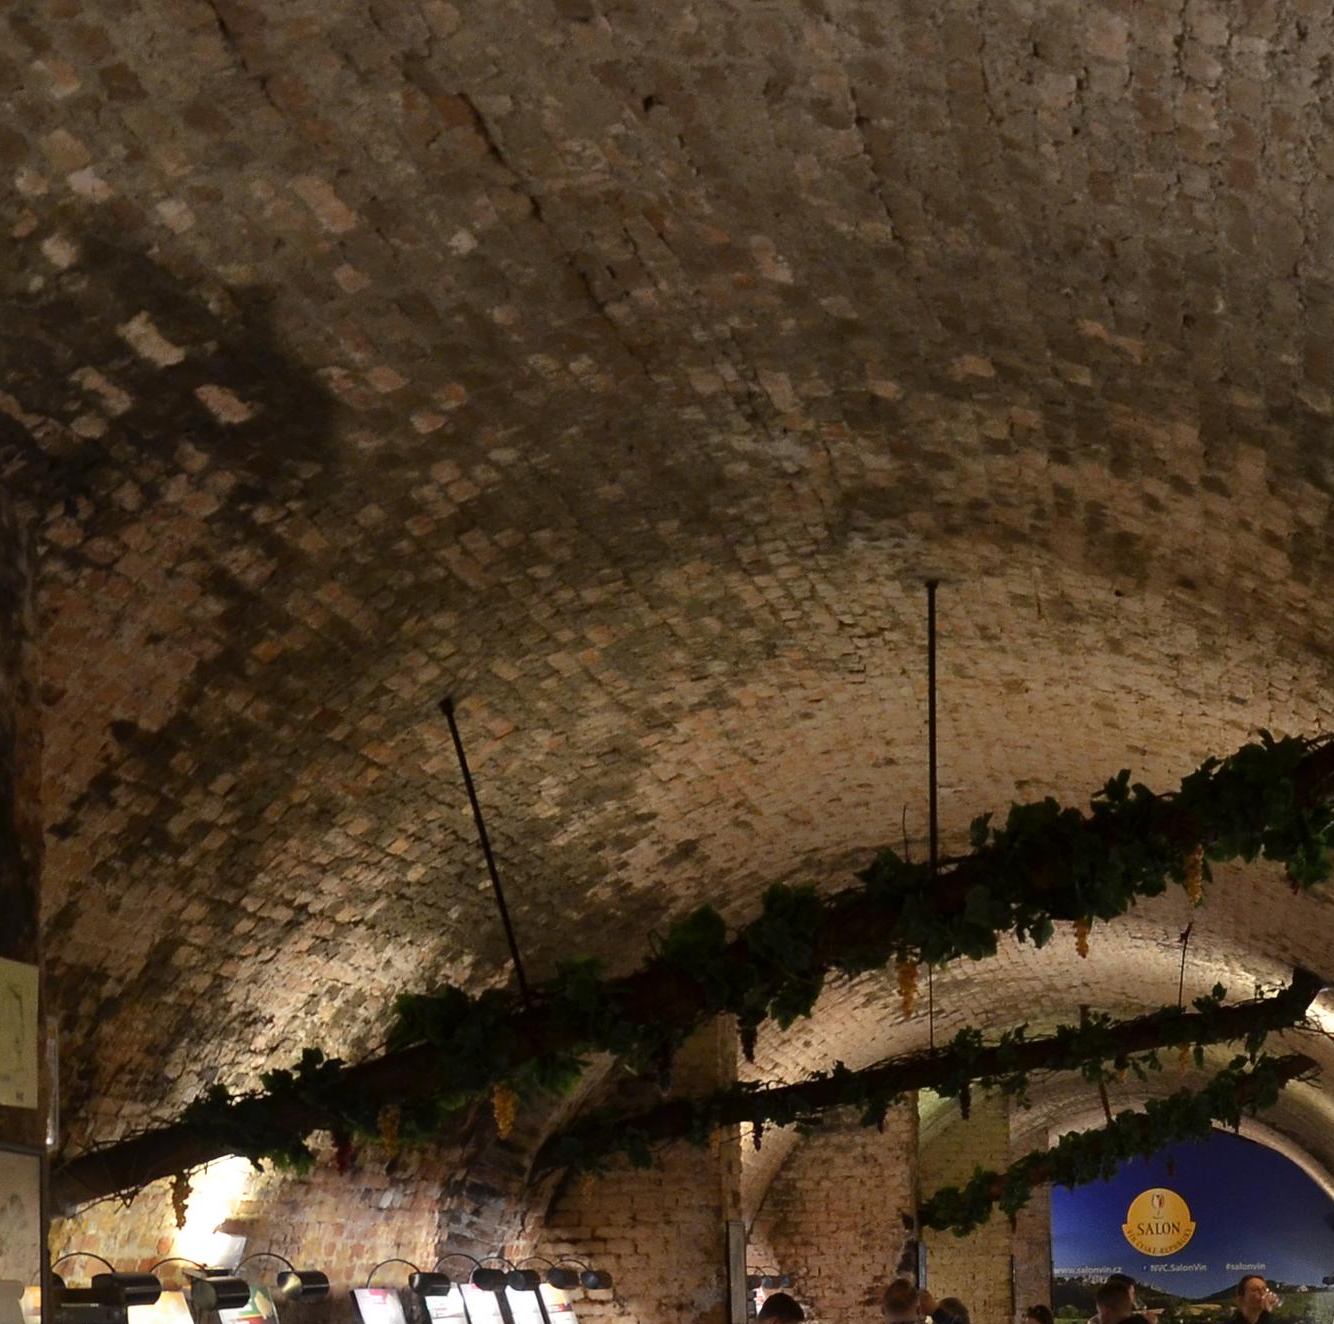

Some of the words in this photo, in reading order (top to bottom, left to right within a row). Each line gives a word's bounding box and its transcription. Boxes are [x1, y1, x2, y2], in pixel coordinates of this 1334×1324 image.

[1137, 1222, 1181, 1236] SALON
[1053, 1265, 1123, 1274] www.salonvin.cz
[1150, 1263, 1207, 1273] NVC.SalonVin
[1225, 1262, 1266, 1271] #salonvin
